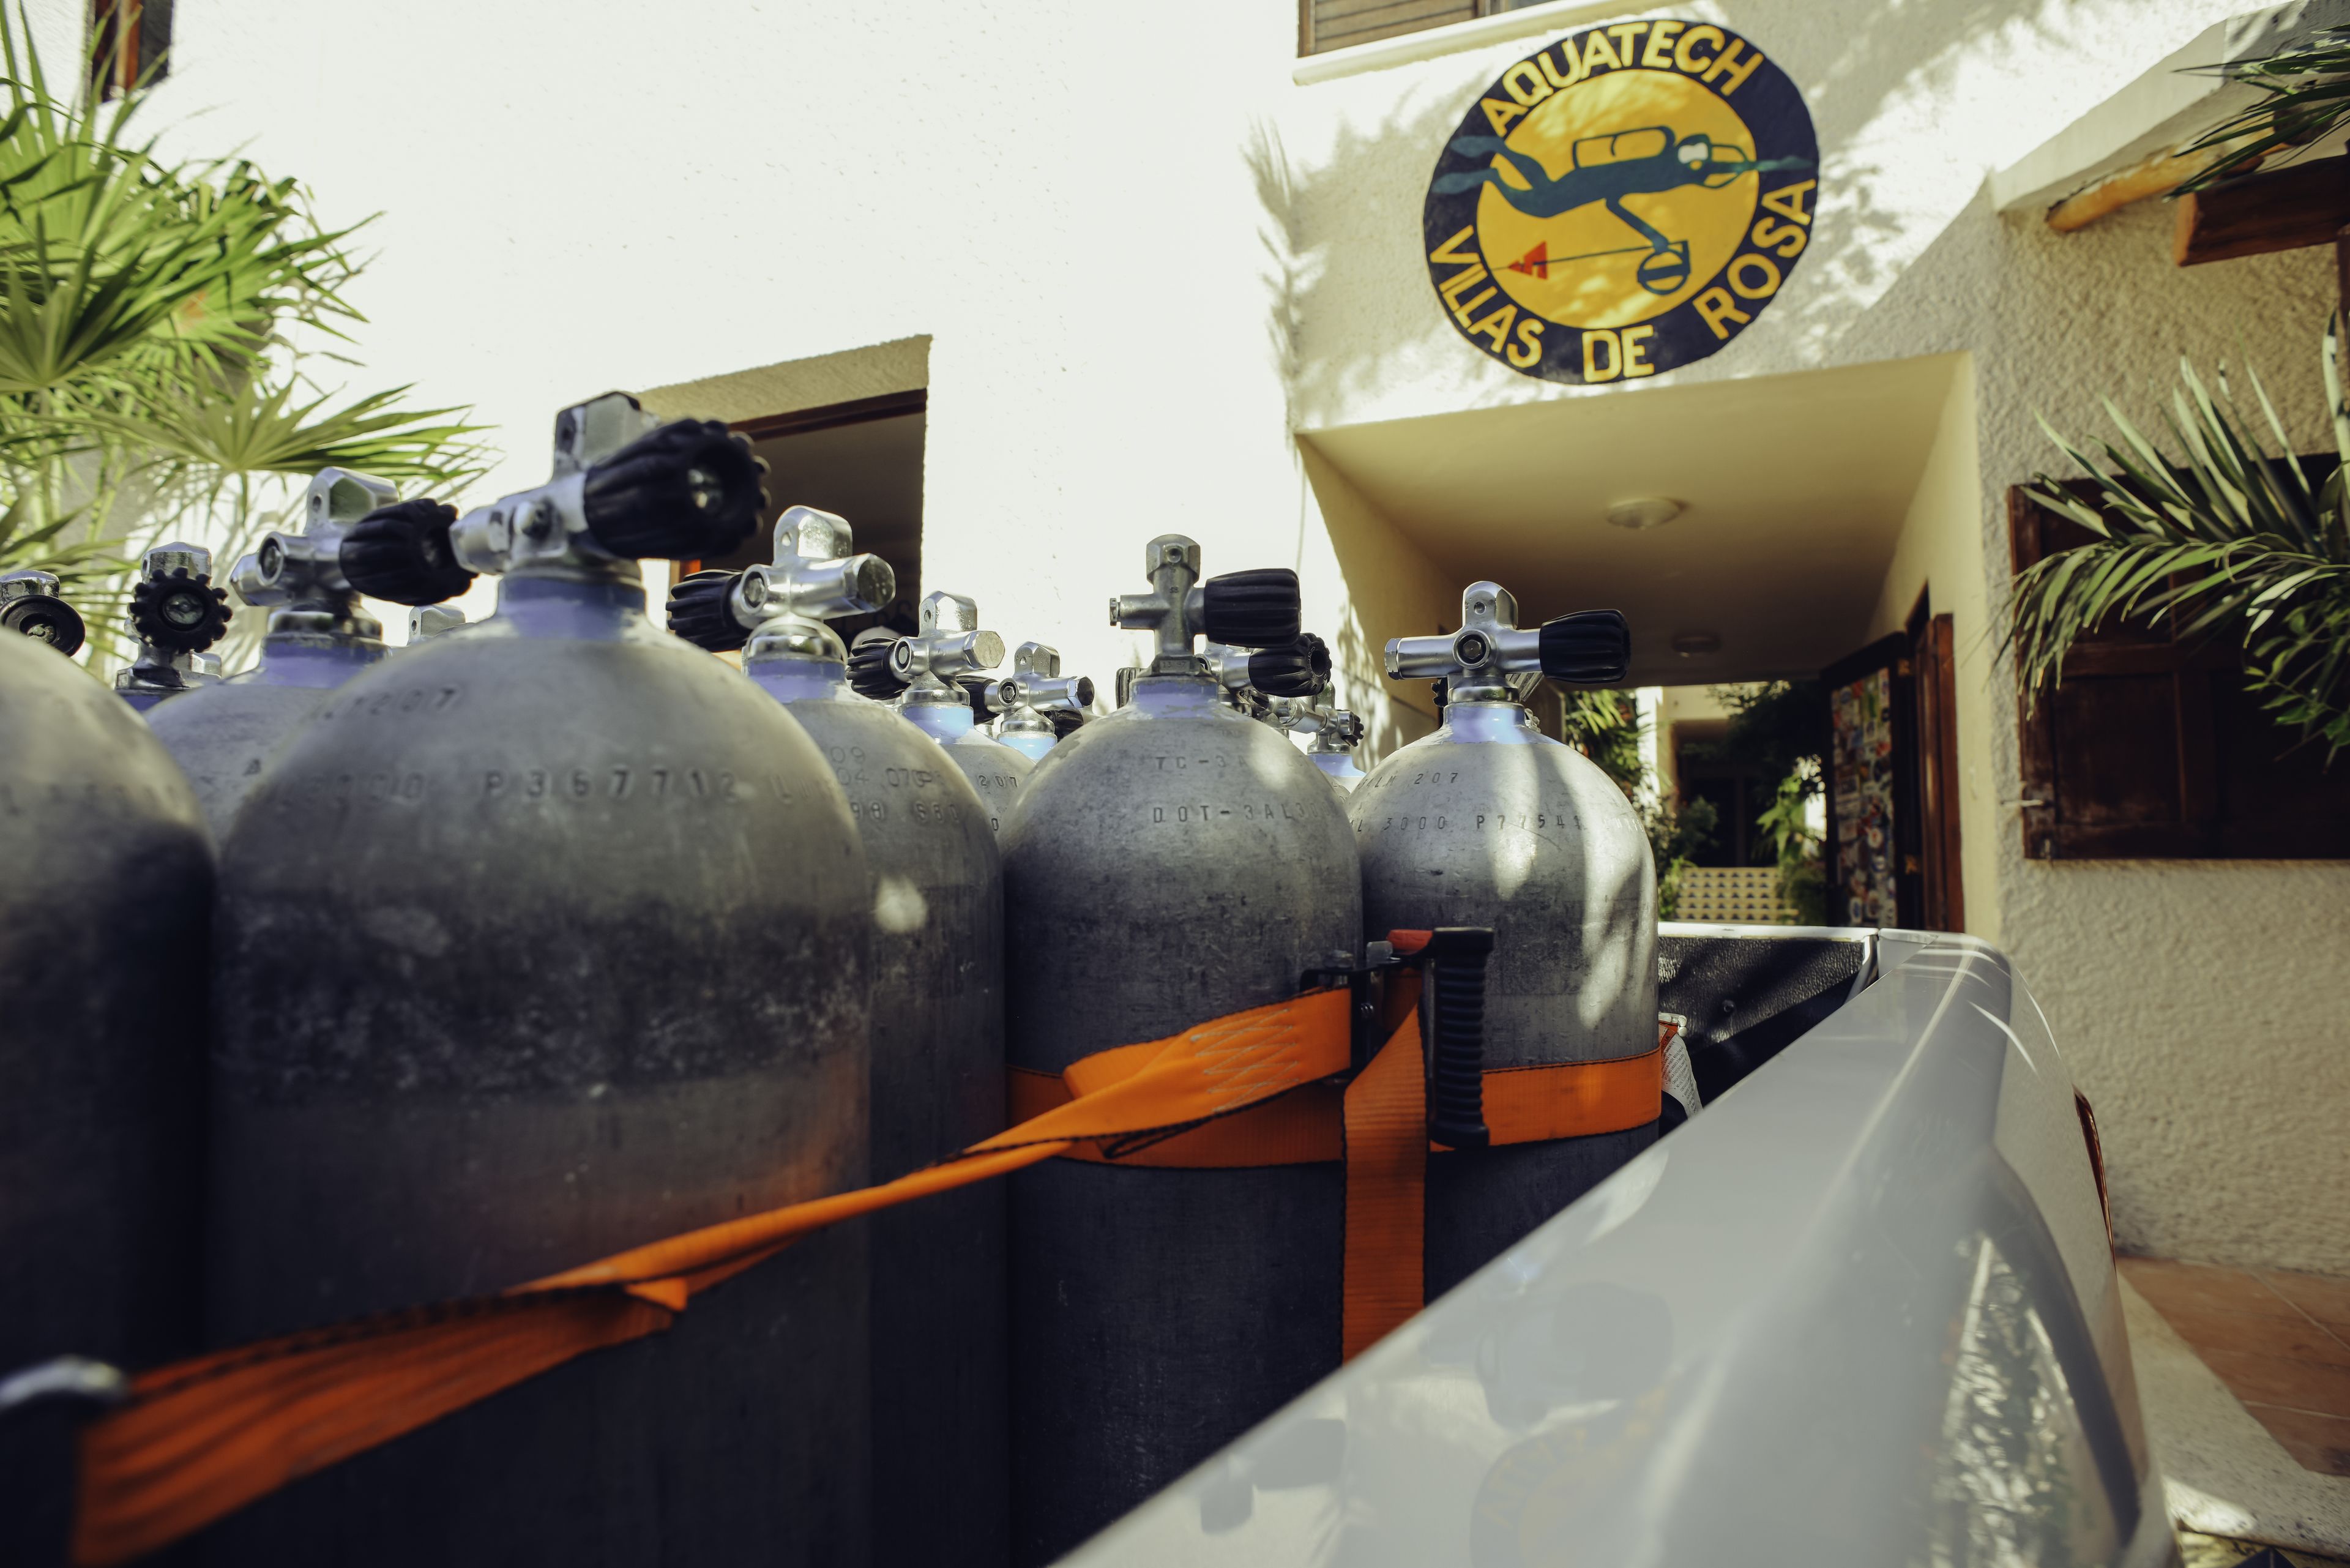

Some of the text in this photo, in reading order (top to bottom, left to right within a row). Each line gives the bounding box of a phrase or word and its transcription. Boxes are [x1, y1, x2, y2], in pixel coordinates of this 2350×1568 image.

[1480, 20, 1764, 137] AQUATECH
[1430, 179, 1816, 383] VILLAS DE ROSA
[1414, 772, 1458, 785] 207
[1382, 816, 1446, 831] 3000
